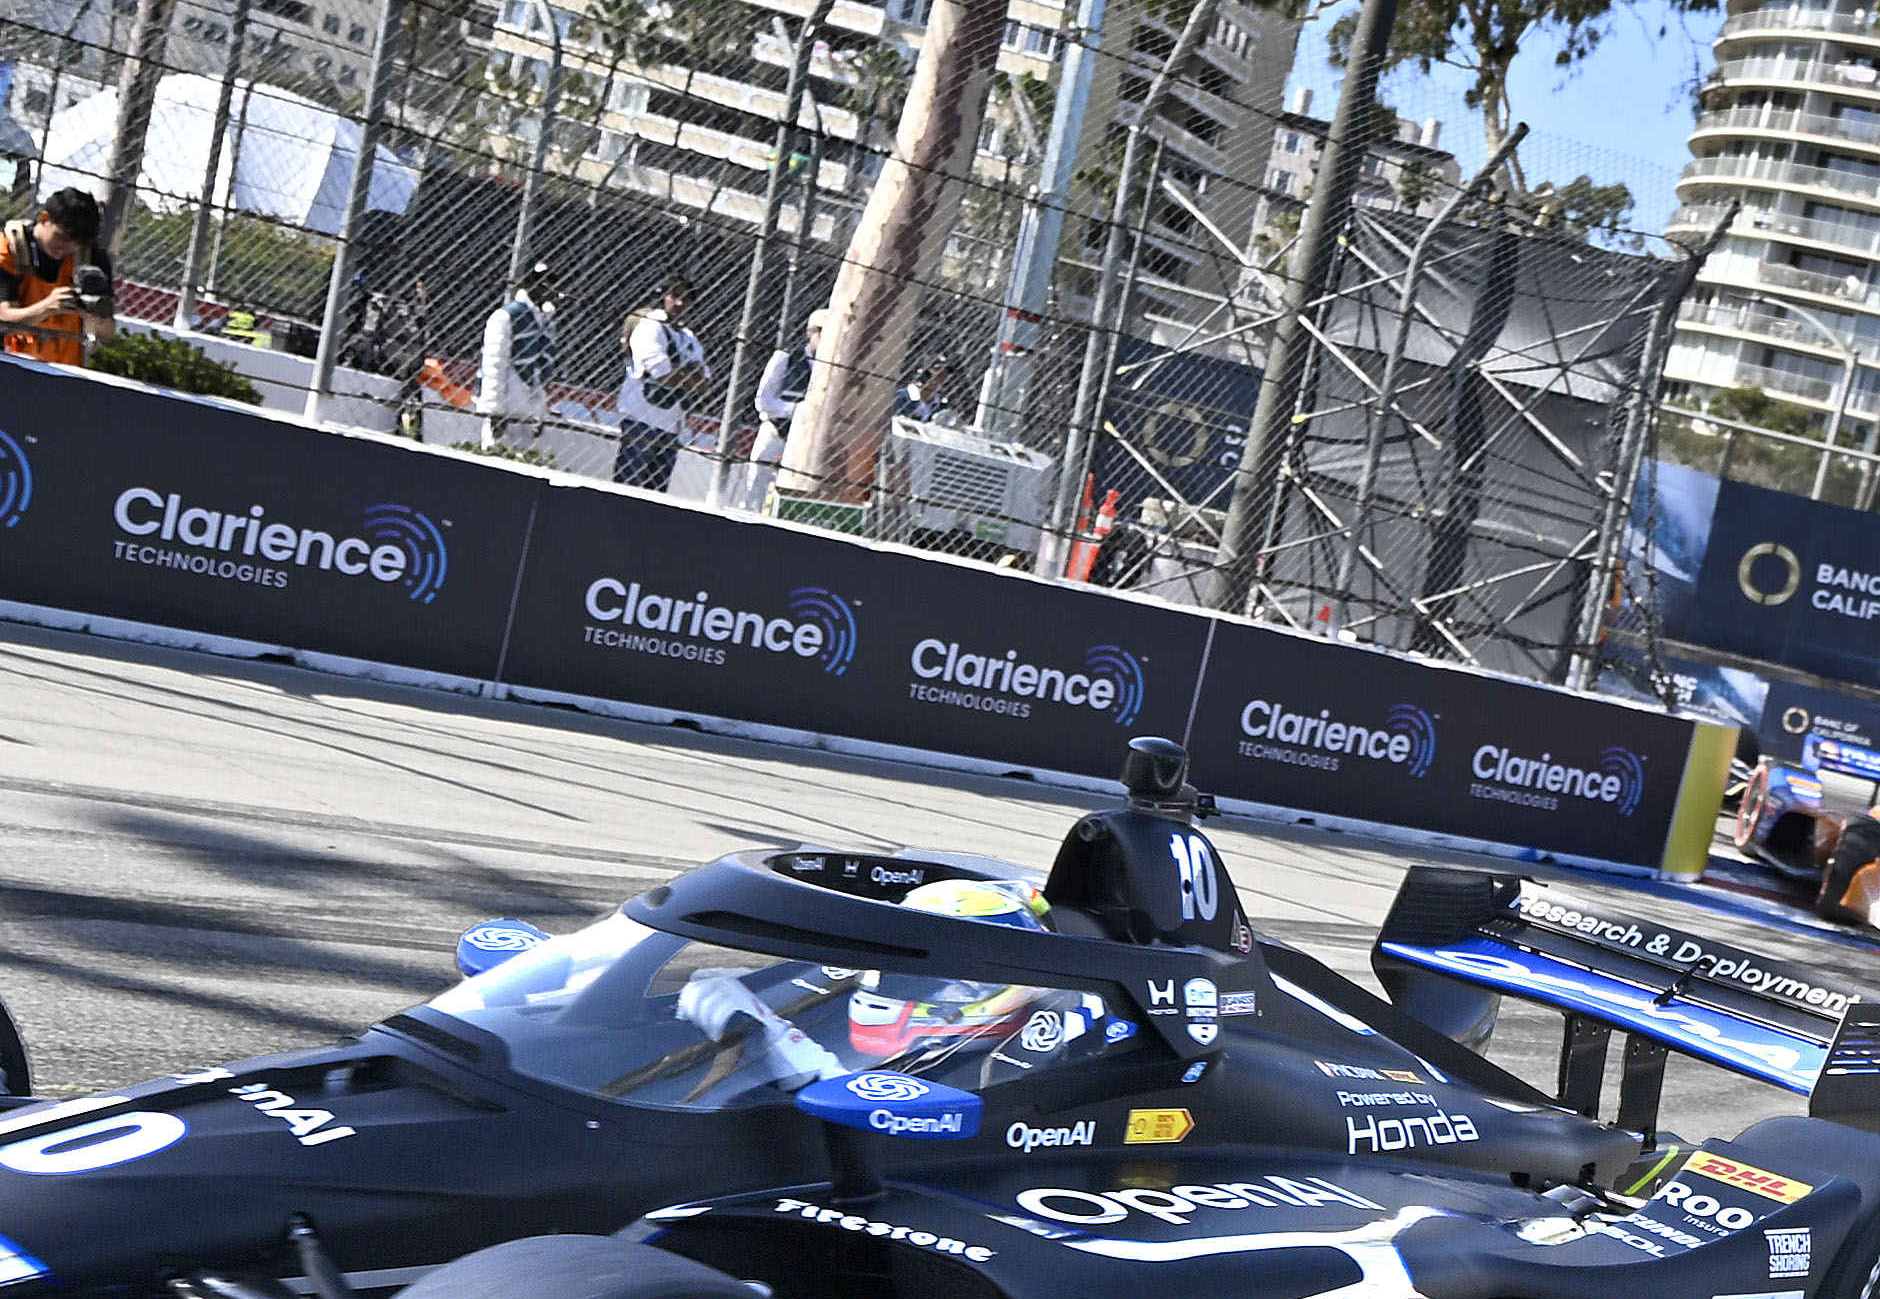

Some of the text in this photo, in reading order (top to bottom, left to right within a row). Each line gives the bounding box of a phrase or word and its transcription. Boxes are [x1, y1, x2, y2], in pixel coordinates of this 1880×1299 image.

[114, 486, 406, 584] Clarience
[113, 540, 288, 589] TECHNOLOGIES
[585, 577, 824, 658] Clarience
[584, 626, 726, 666] TECHNOLOGIES
[911, 639, 1116, 711] Clarience
[909, 683, 1031, 719] TECHNOLOGIES
[1241, 700, 1412, 765] Clarience
[1472, 744, 1621, 803] Clarience
[870, 865, 925, 887] OpenAI
[1169, 833, 1219, 921] 10
[1509, 894, 1642, 948] Research
[1645, 931, 1670, 954] &
[870, 1109, 964, 1136] OpenAI
[1336, 1090, 1417, 1107] Powered
[1006, 1120, 1097, 1154] OpenAI
[1345, 1108, 1480, 1156] Honda
[1016, 1174, 1387, 1226] OpenAI
[1700, 1158, 1790, 1198] DHL
[1653, 1180, 1768, 1230] ROO
[773, 1197, 996, 1264] Firestone
[1765, 1233, 1812, 1255] TRENCH
[1768, 1253, 1812, 1273] SHORING
